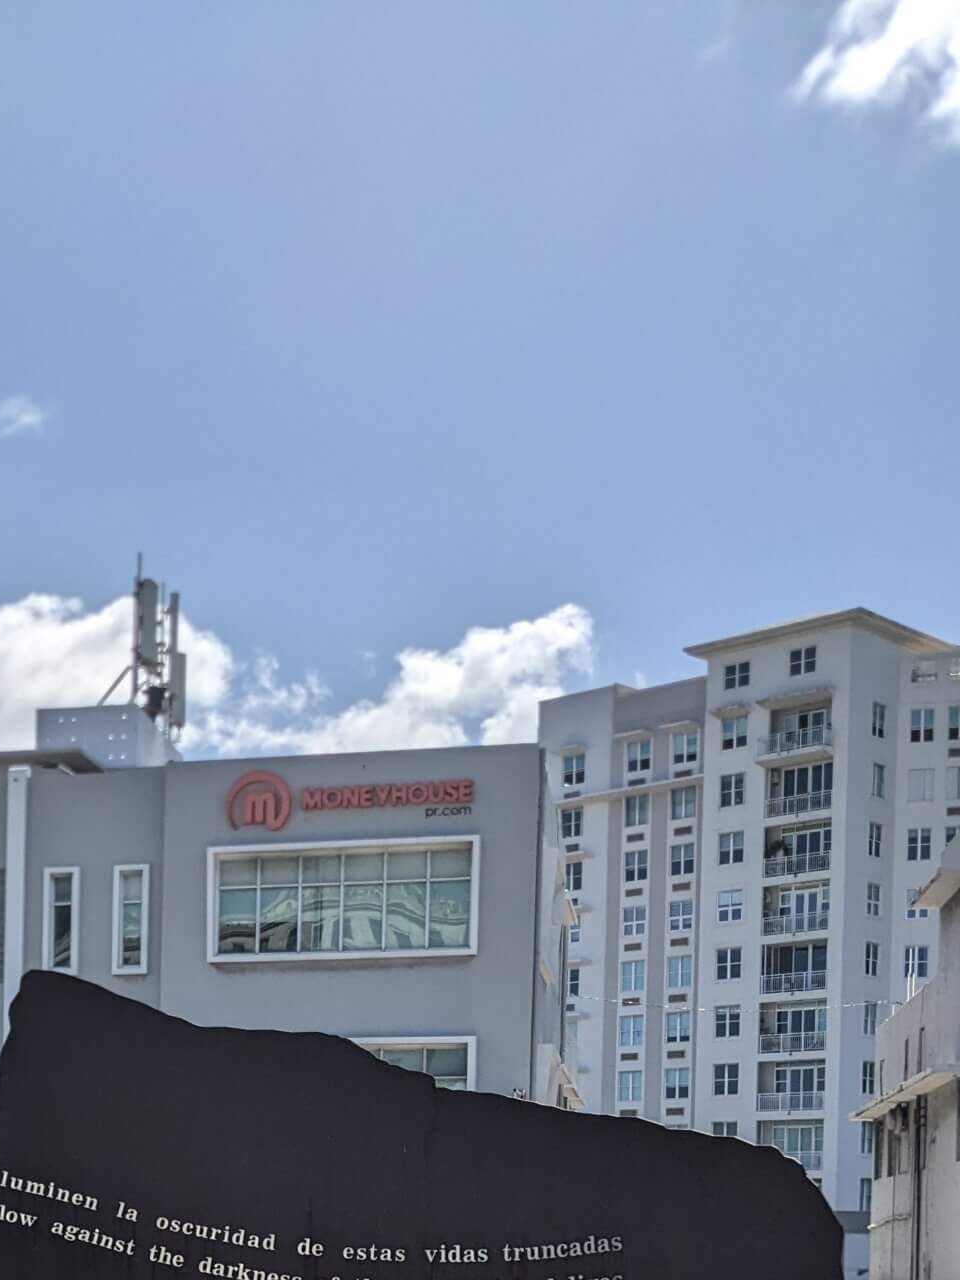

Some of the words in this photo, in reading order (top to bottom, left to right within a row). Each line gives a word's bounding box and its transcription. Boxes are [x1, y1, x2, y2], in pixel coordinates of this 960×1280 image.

[301, 779, 474, 813] MONEYHOUSE
[424, 804, 472, 818] pr.com
[50, 1222, 136, 1256] against
[149, 1244, 185, 1268] the
[116, 1201, 138, 1223] la
[156, 1216, 276, 1251] oscuridad
[297, 1237, 324, 1257] de
[342, 1243, 406, 1262] estas
[424, 1244, 489, 1263] vidas
[502, 1236, 623, 1262] truncadas
